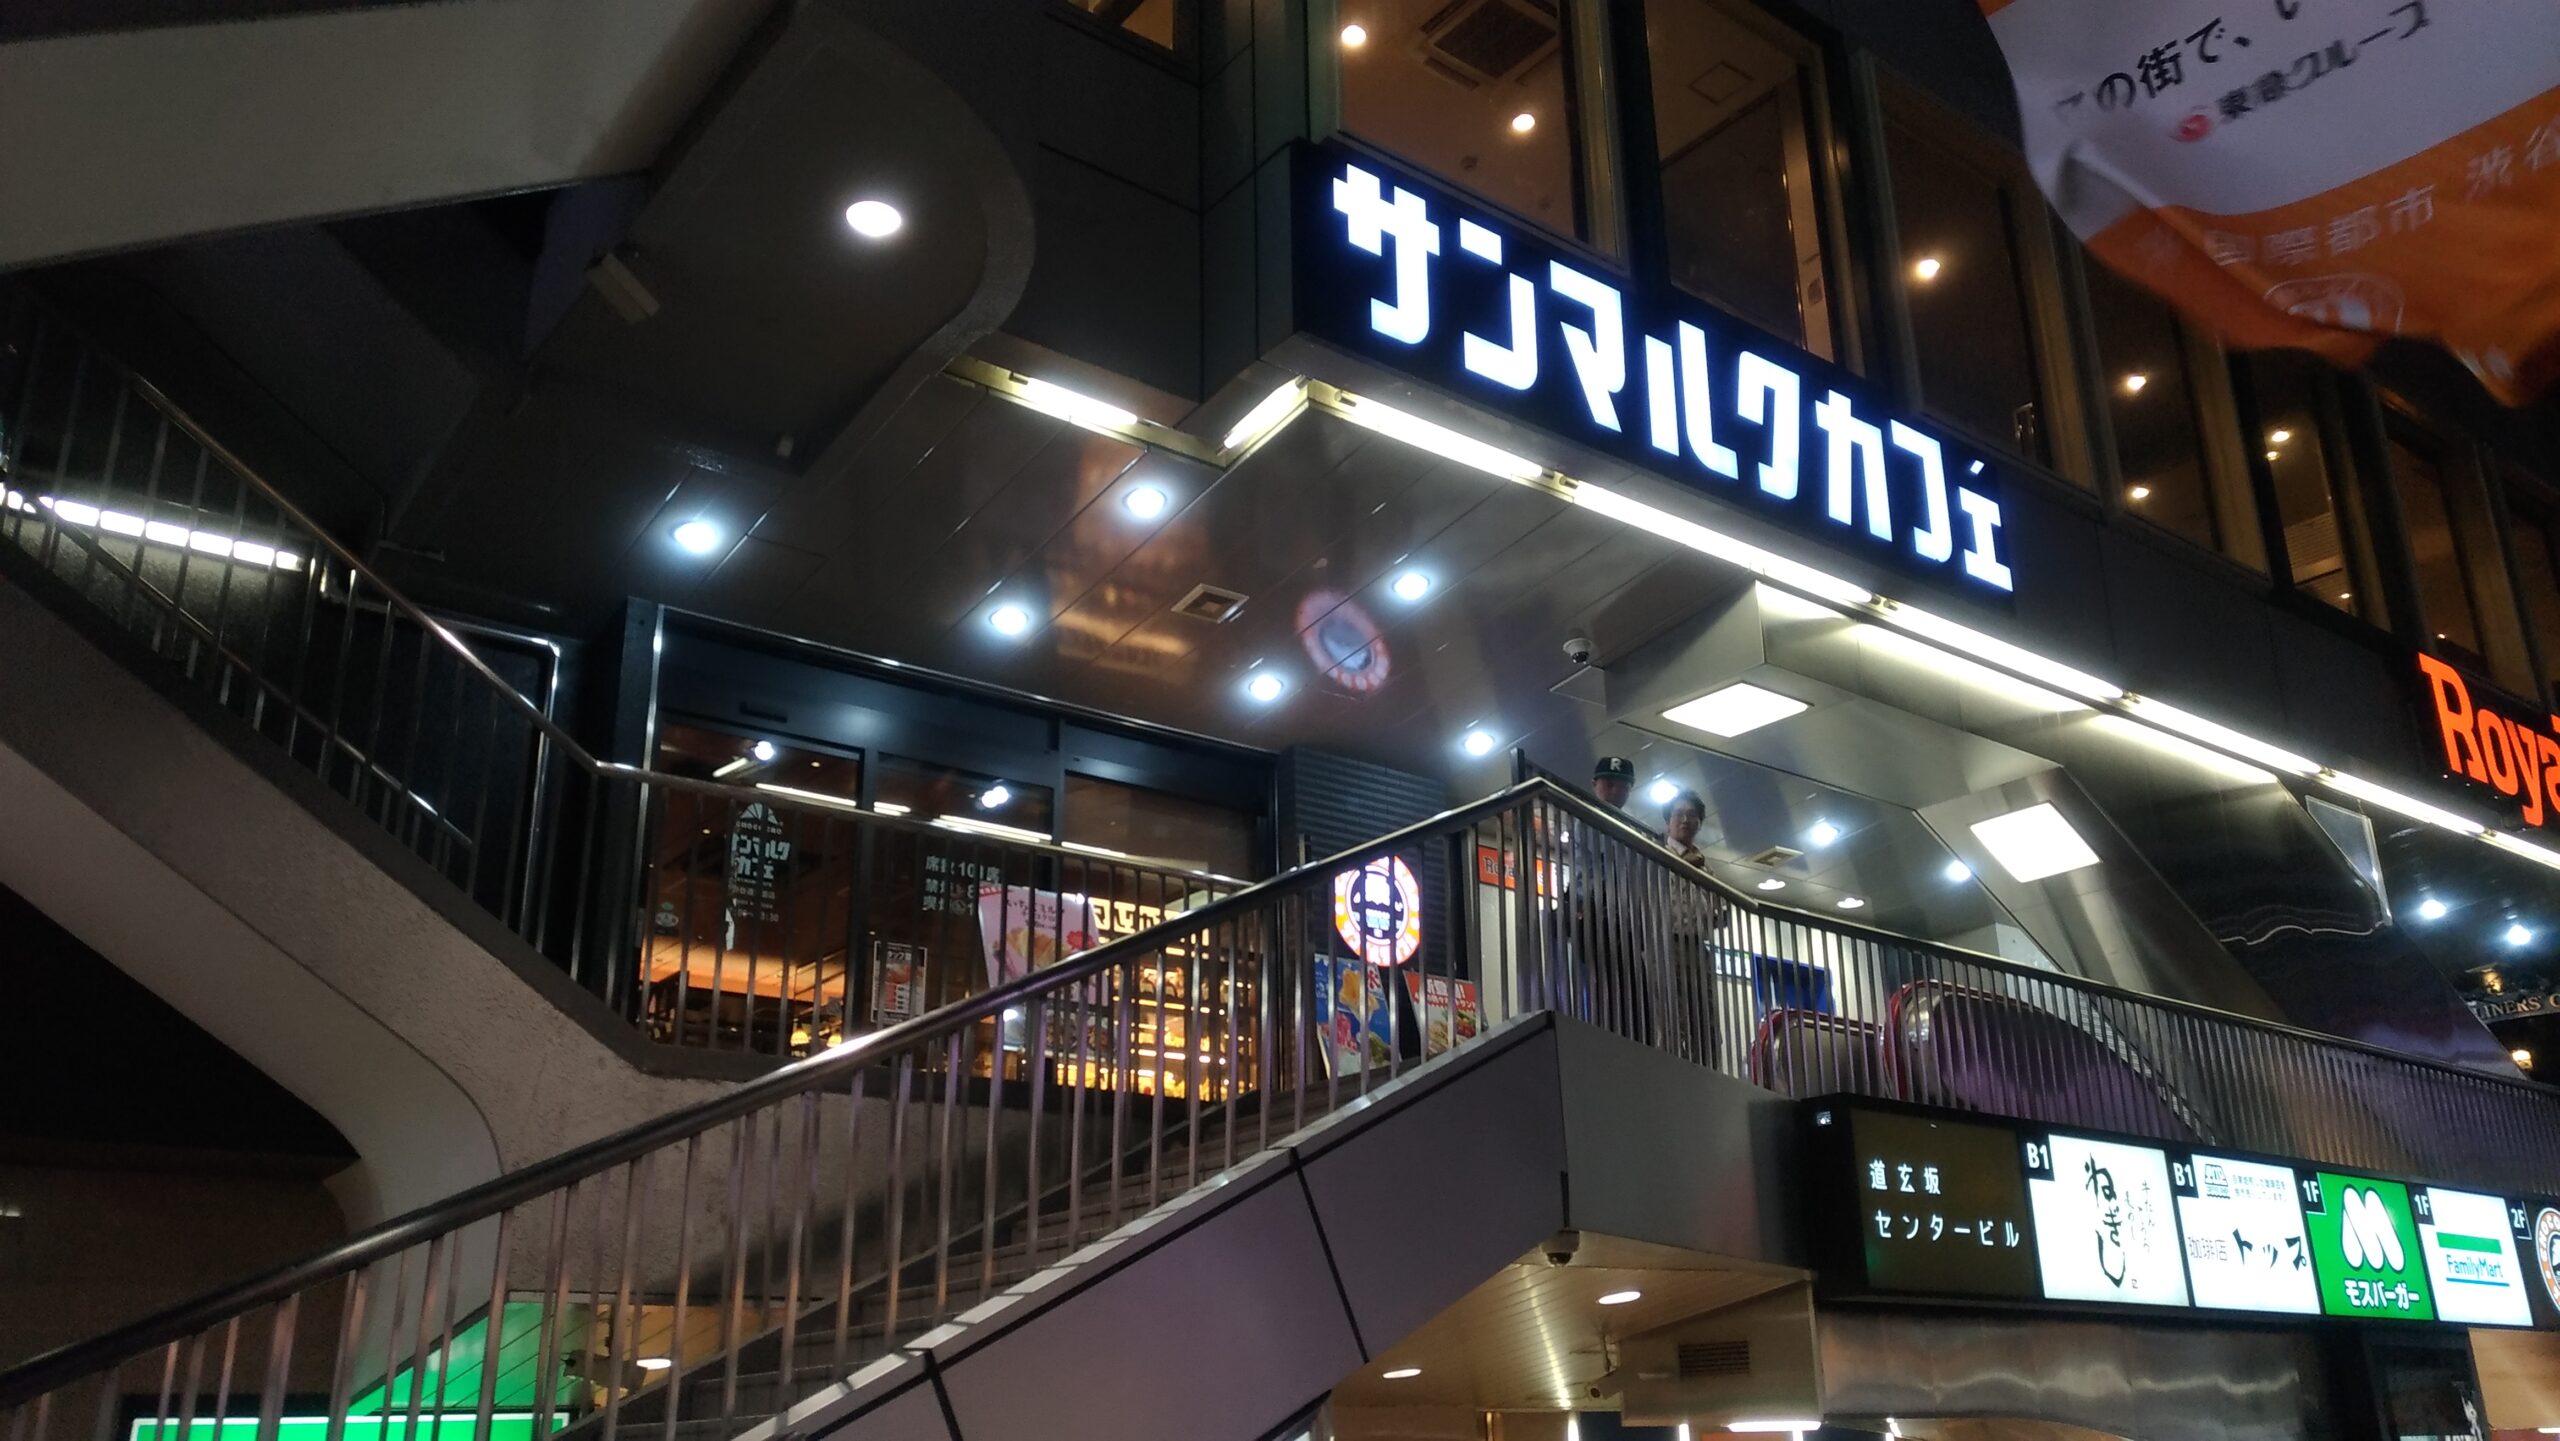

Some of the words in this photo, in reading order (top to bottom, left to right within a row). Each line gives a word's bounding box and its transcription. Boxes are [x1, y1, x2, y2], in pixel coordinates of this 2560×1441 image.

[1333, 163, 2013, 592] サンマルクカフェ
[2418, 652, 2560, 826] Roya
[1610, 757, 1622, 772] R
[2026, 1142, 2050, 1170] B1
[1869, 1160, 1941, 1195] 道玄坂
[2173, 1162, 2194, 1188] B1
[2302, 1180, 2320, 1203] 1F
[2414, 1194, 2430, 1216] 1F
[1875, 1209, 2020, 1248] センタービル
[2084, 1152, 2126, 1288] ねぎし
[2510, 1207, 2526, 1230] 2F
[2232, 1228, 2307, 1272] トップ
[2446, 1253, 2504, 1279] FamilyMart
[2344, 1279, 2420, 1311] モスバーガー
